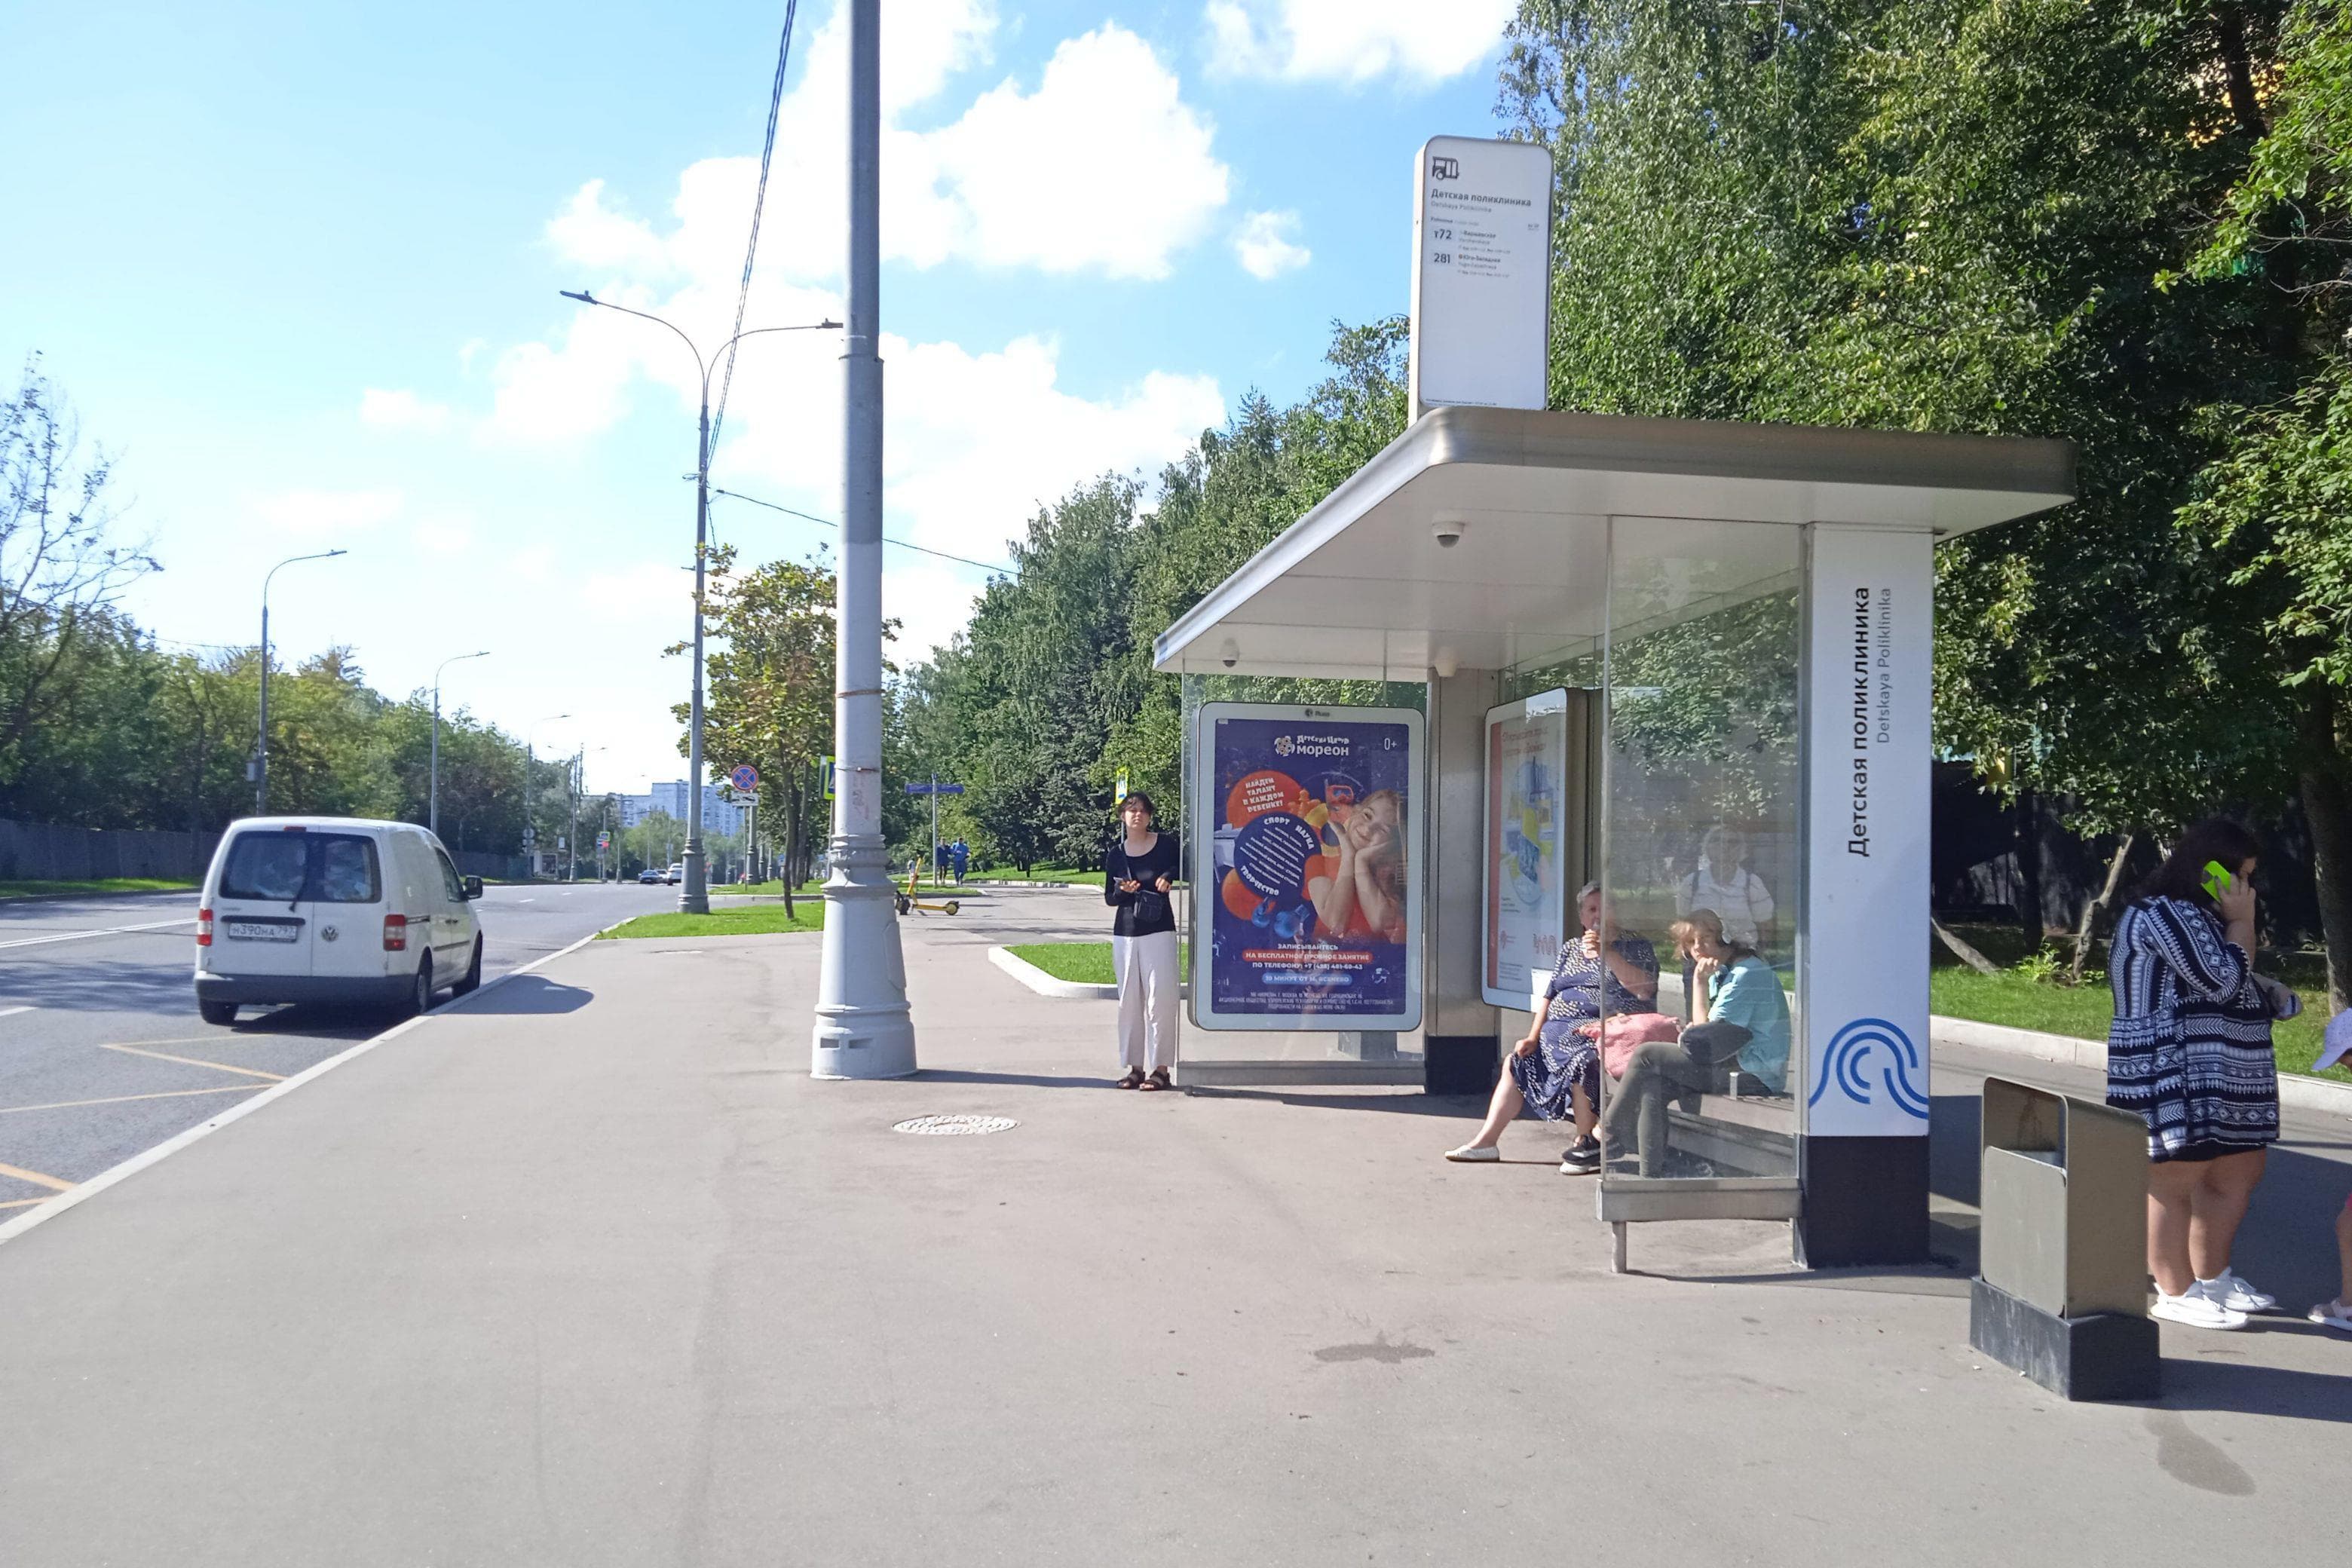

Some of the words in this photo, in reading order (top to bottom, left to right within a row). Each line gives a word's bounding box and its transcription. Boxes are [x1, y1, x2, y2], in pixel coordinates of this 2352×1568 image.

[1431, 188, 1468, 201] Детская
[1471, 194, 1531, 207] поликлиника
[1434, 253, 1450, 264] 281
[1877, 588, 1891, 668] Poliklinika
[1853, 587, 1870, 750] поликлиника
[1877, 674, 1894, 743] Detskaya
[1384, 738, 1397, 750] 0+
[1247, 786, 1276, 796] ТАЛАНТ
[1249, 792, 1284, 804] КАЖДОМ
[1848, 758, 1870, 857] Детская
[1263, 816, 1290, 825] СПОРТ
[1295, 825, 1315, 850] НАУКА
[1241, 865, 1279, 896] ТВОРЧЕСТВО
